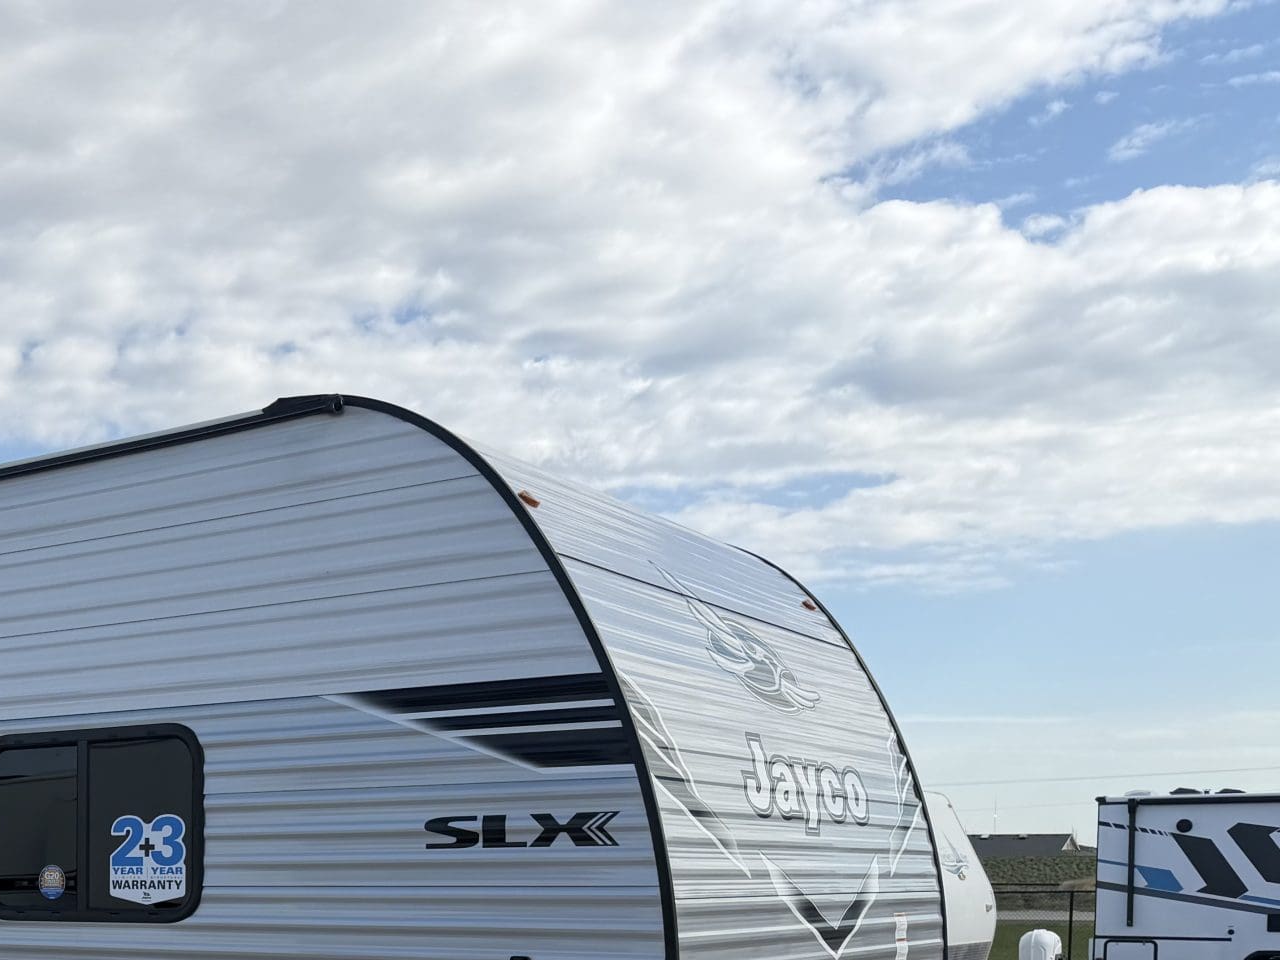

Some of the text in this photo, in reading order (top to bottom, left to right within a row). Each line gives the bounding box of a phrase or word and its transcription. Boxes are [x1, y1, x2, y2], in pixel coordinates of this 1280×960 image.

[742, 733, 870, 835] Jayco
[424, 811, 620, 849] SLX
[113, 867, 183, 875] YEAR YEAR
[112, 880, 183, 890] WARRANTY
